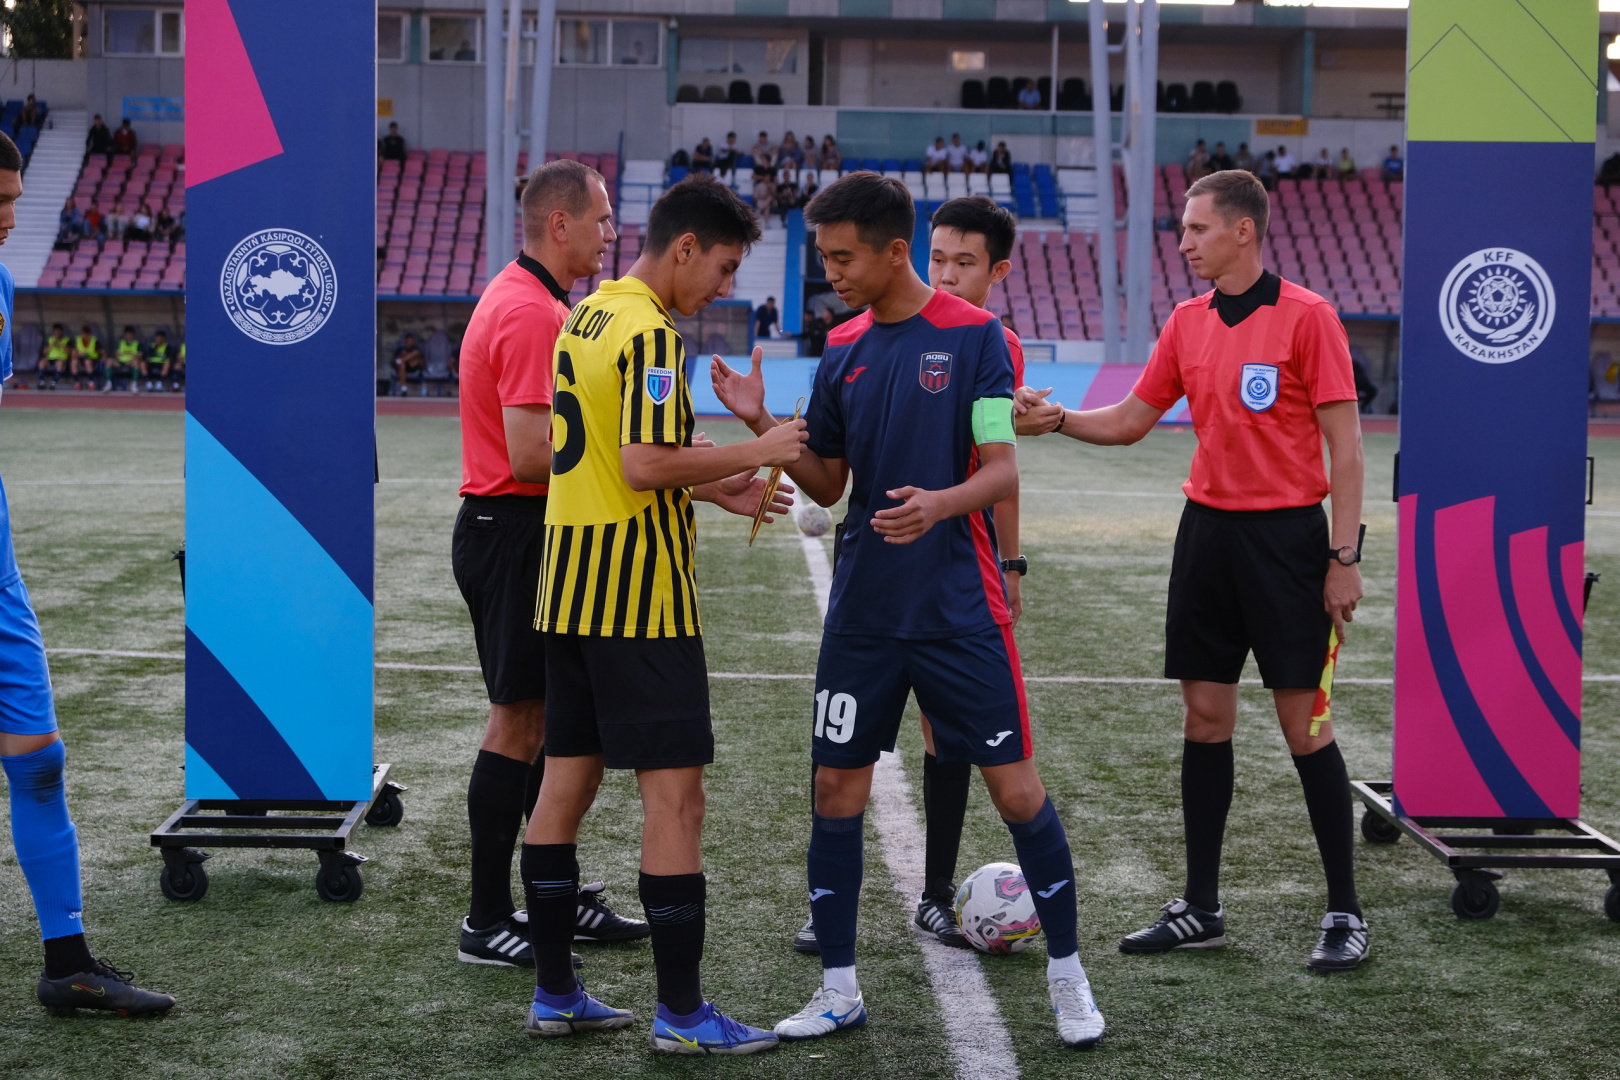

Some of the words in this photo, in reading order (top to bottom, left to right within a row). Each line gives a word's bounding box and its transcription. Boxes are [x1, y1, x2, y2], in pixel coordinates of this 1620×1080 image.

[1483, 251, 1514, 263] KFF
[324, 274, 334, 308] LIGASY
[1454, 333, 1539, 359] KAZAKHSTAN
[814, 688, 858, 744] 19
